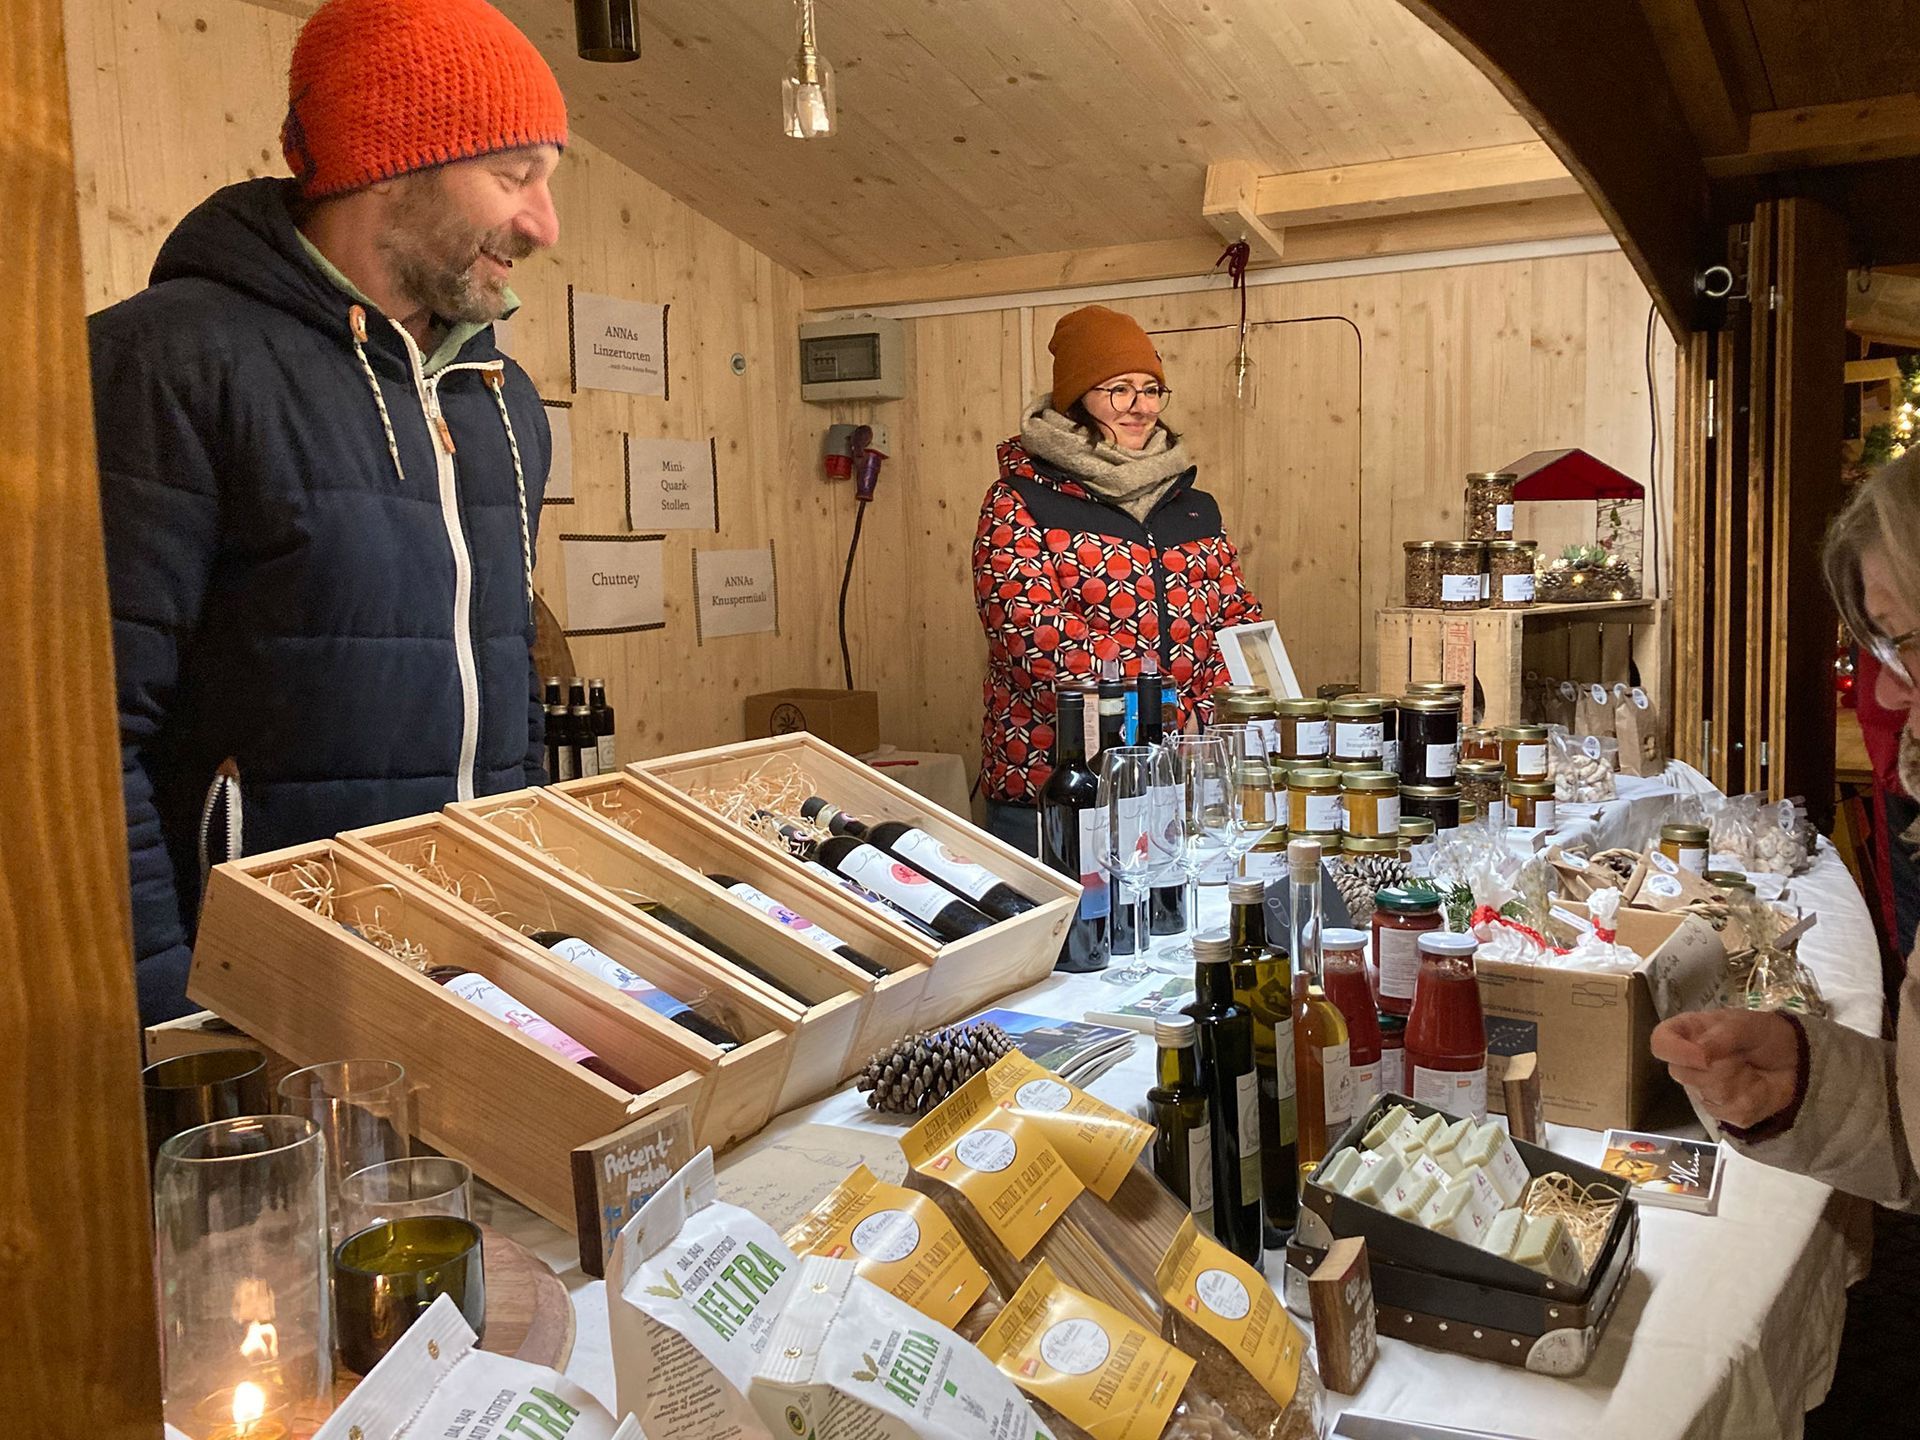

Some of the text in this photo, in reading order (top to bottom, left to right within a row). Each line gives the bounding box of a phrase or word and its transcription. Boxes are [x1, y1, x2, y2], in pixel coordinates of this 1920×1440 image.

[604, 325, 639, 342] ANNAs
[593, 343, 652, 362] Linzertorten
[662, 460, 685, 472] Mini-
[660, 479, 689, 493] Quark-
[661, 499, 690, 511] Stollen
[591, 562, 641, 589] Chutney
[724, 575, 754, 588] ANNAs
[711, 591, 767, 608] Knuspermüsli
[604, 1130, 674, 1184] Präsent-
[1667, 1147, 1700, 1188] Wein
[675, 1253, 694, 1272] DAL
[702, 1234, 737, 1272] PASTIFICIO
[690, 1239, 787, 1342] AFELTRA
[889, 1268, 926, 1303] GATONI
[883, 1328, 941, 1408] AFELTRA
[1088, 1375, 1119, 1410] PENNE
[479, 1387, 517, 1428] PASTIFICIO
